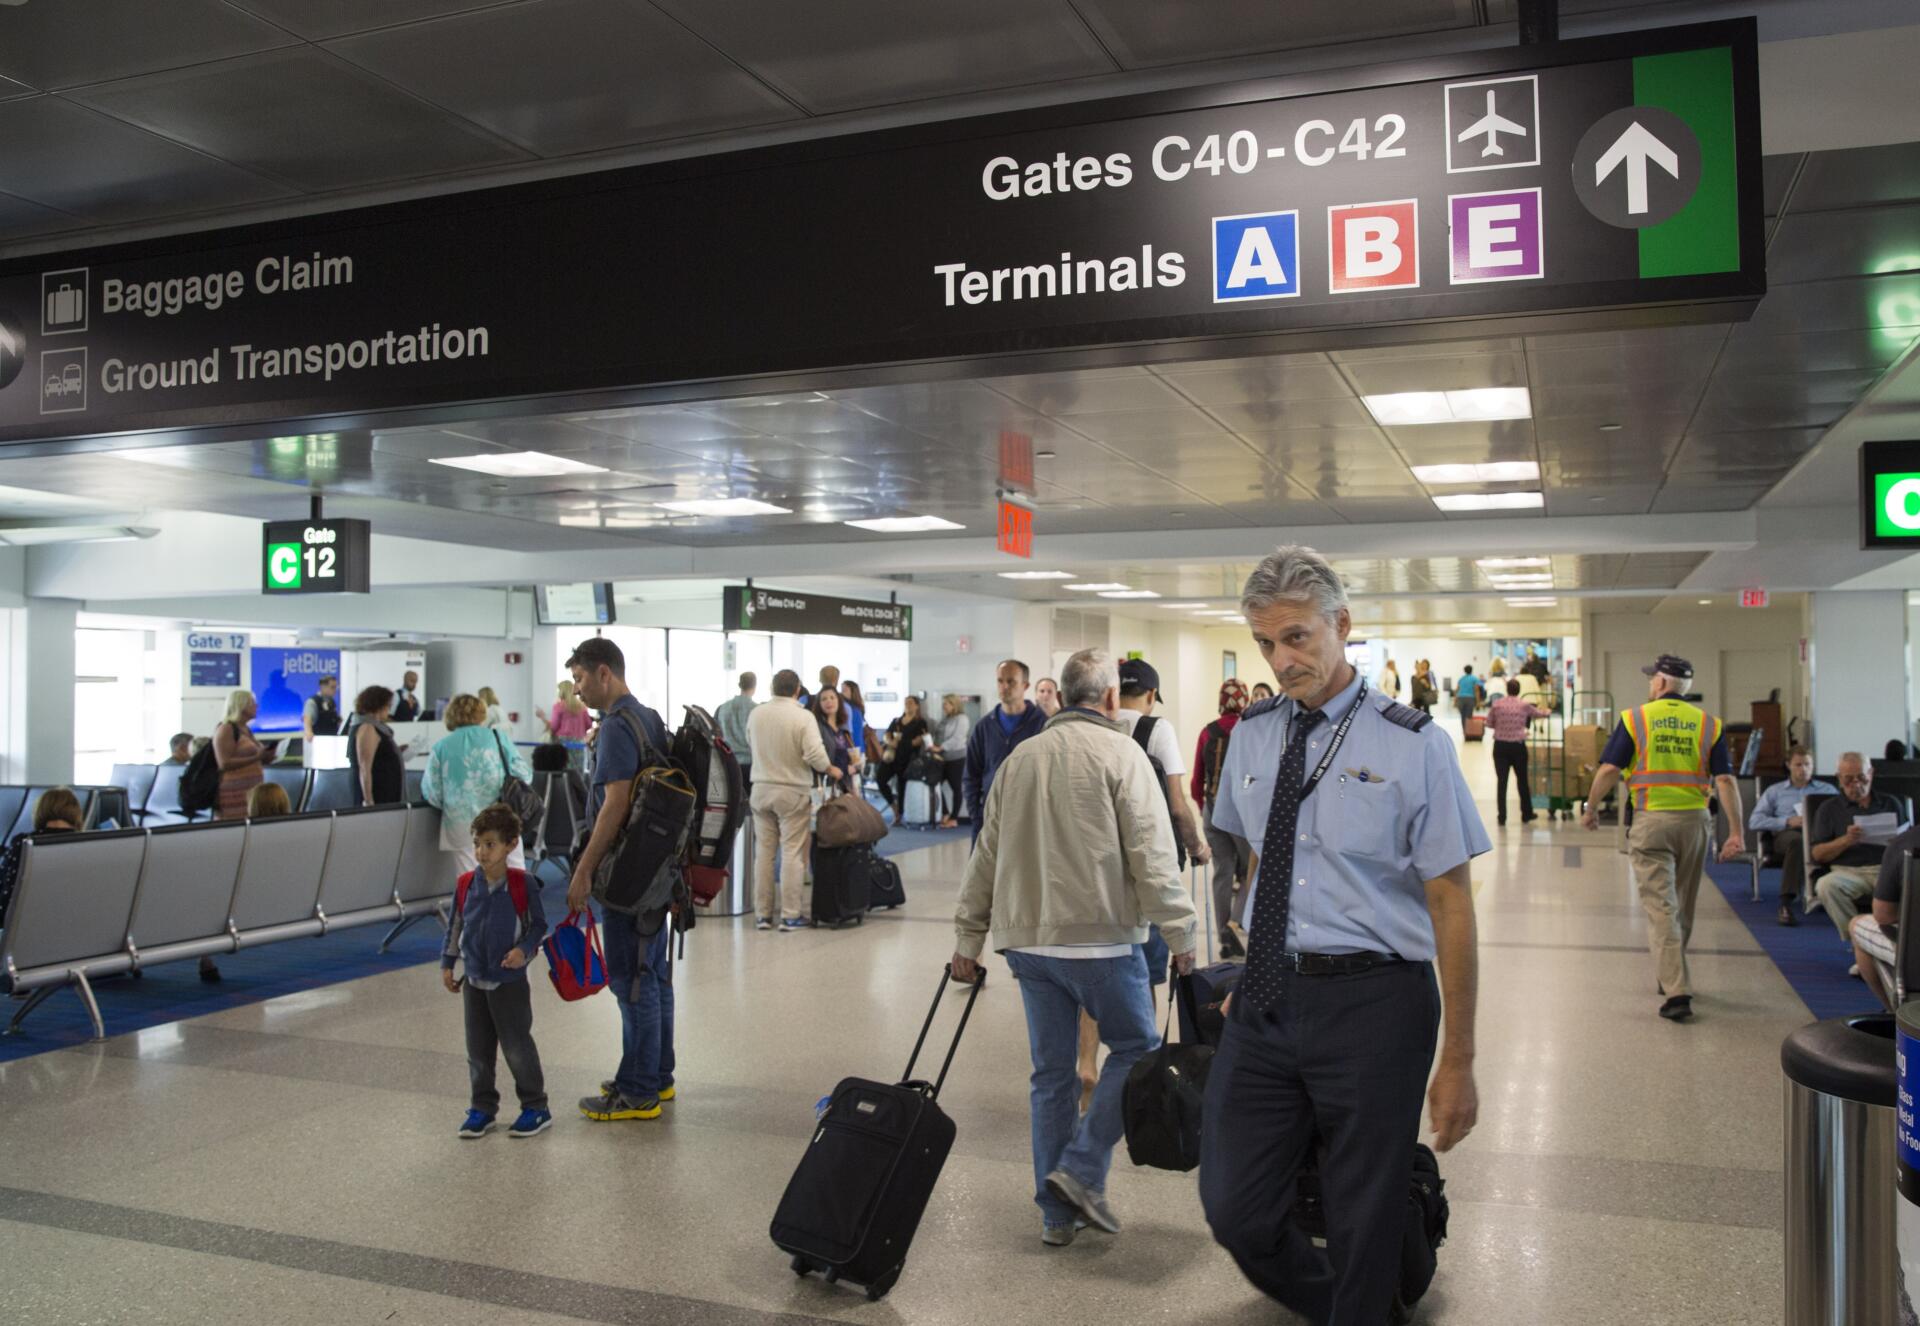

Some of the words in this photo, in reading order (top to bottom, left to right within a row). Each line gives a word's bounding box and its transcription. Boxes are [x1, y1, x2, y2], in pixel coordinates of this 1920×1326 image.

[982, 152, 1133, 201] Gates
[934, 244, 1187, 306] Terminals
[1225, 226, 1288, 289] A
[1344, 215, 1402, 279] B
[1467, 204, 1524, 268] E
[102, 271, 244, 318] Baggage
[255, 252, 353, 296] Claim
[101, 347, 219, 393] Ground
[231, 324, 489, 381] Transportation
[303, 527, 336, 544] Gate
[270, 546, 297, 584] C
[303, 546, 336, 578] 12
[1743, 591, 1766, 607] EXIT
[187, 633, 223, 649] Gate
[229, 635, 245, 650] 12
[281, 652, 338, 678] jetBlue
[1651, 716, 1697, 731] jetBlue
[1906, 1131, 1920, 1152] Foo
